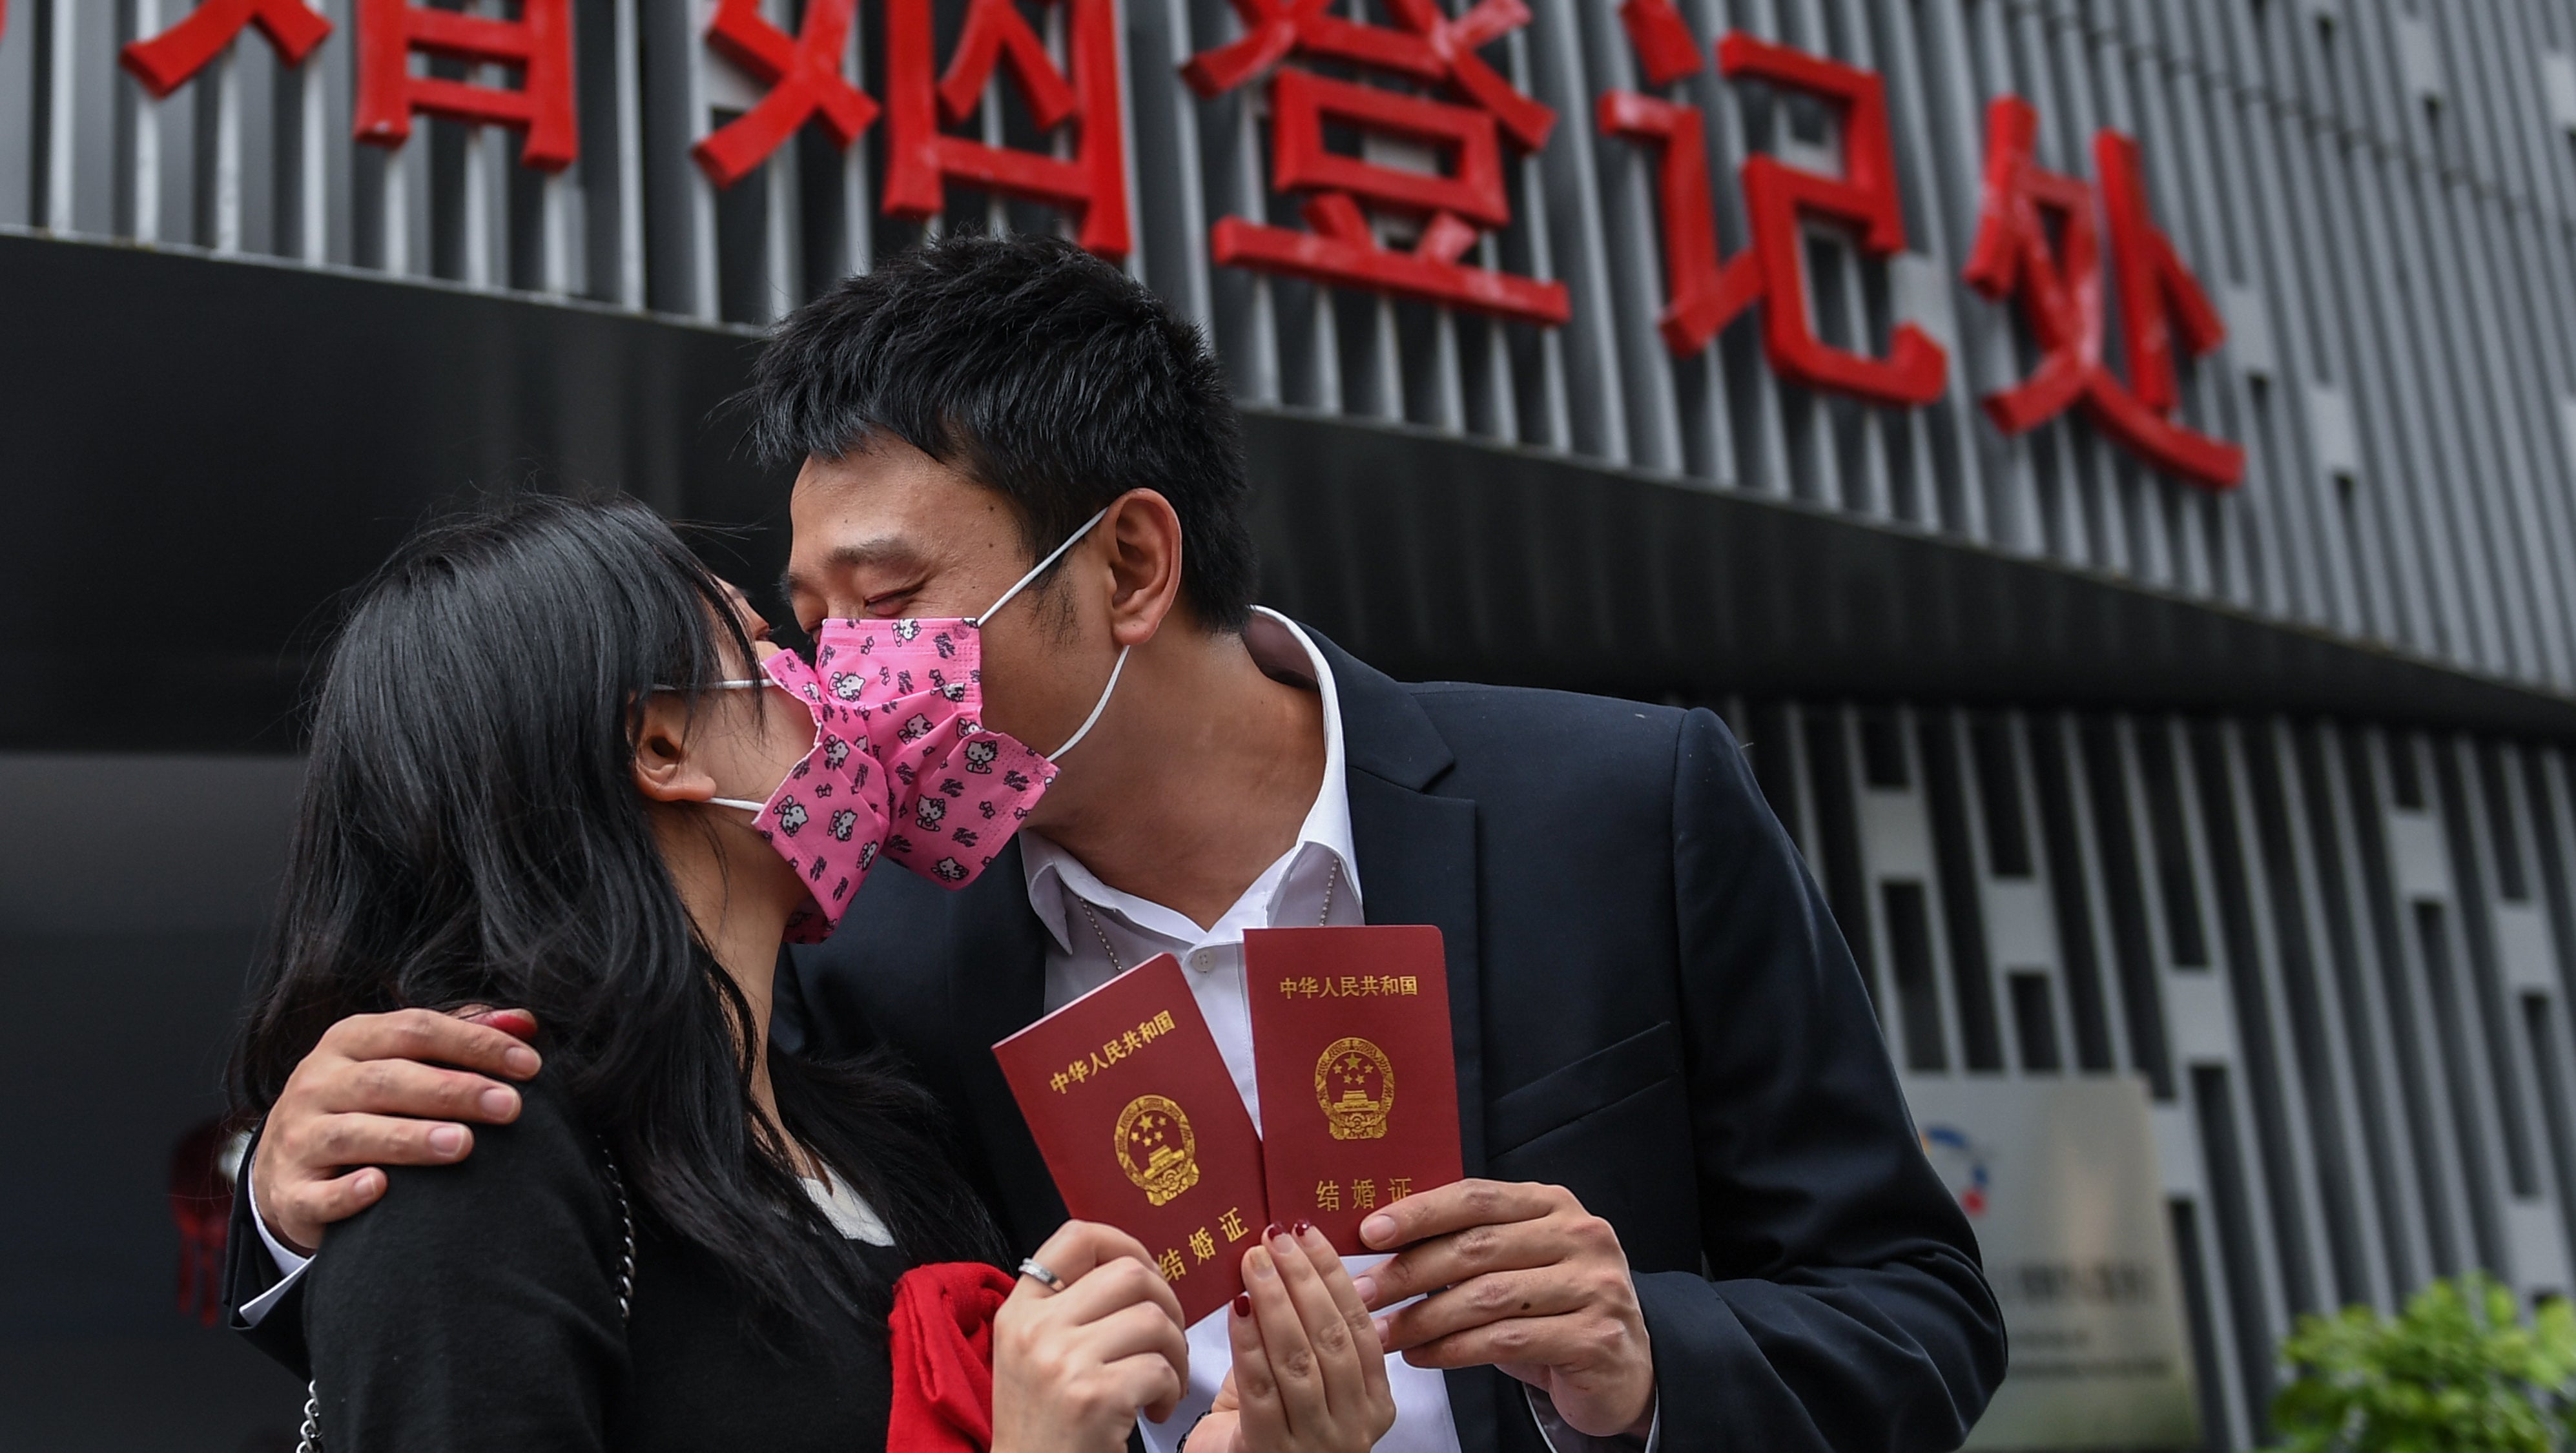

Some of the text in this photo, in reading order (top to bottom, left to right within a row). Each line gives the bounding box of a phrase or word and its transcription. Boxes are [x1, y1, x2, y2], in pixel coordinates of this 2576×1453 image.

[1280, 975, 1418, 1000] 中华人民共和国
[1049, 1009, 1176, 1095] 中华人民共和国
[1315, 1177, 1412, 1211] 结婚证
[1158, 1206, 1250, 1283] 结婚证
